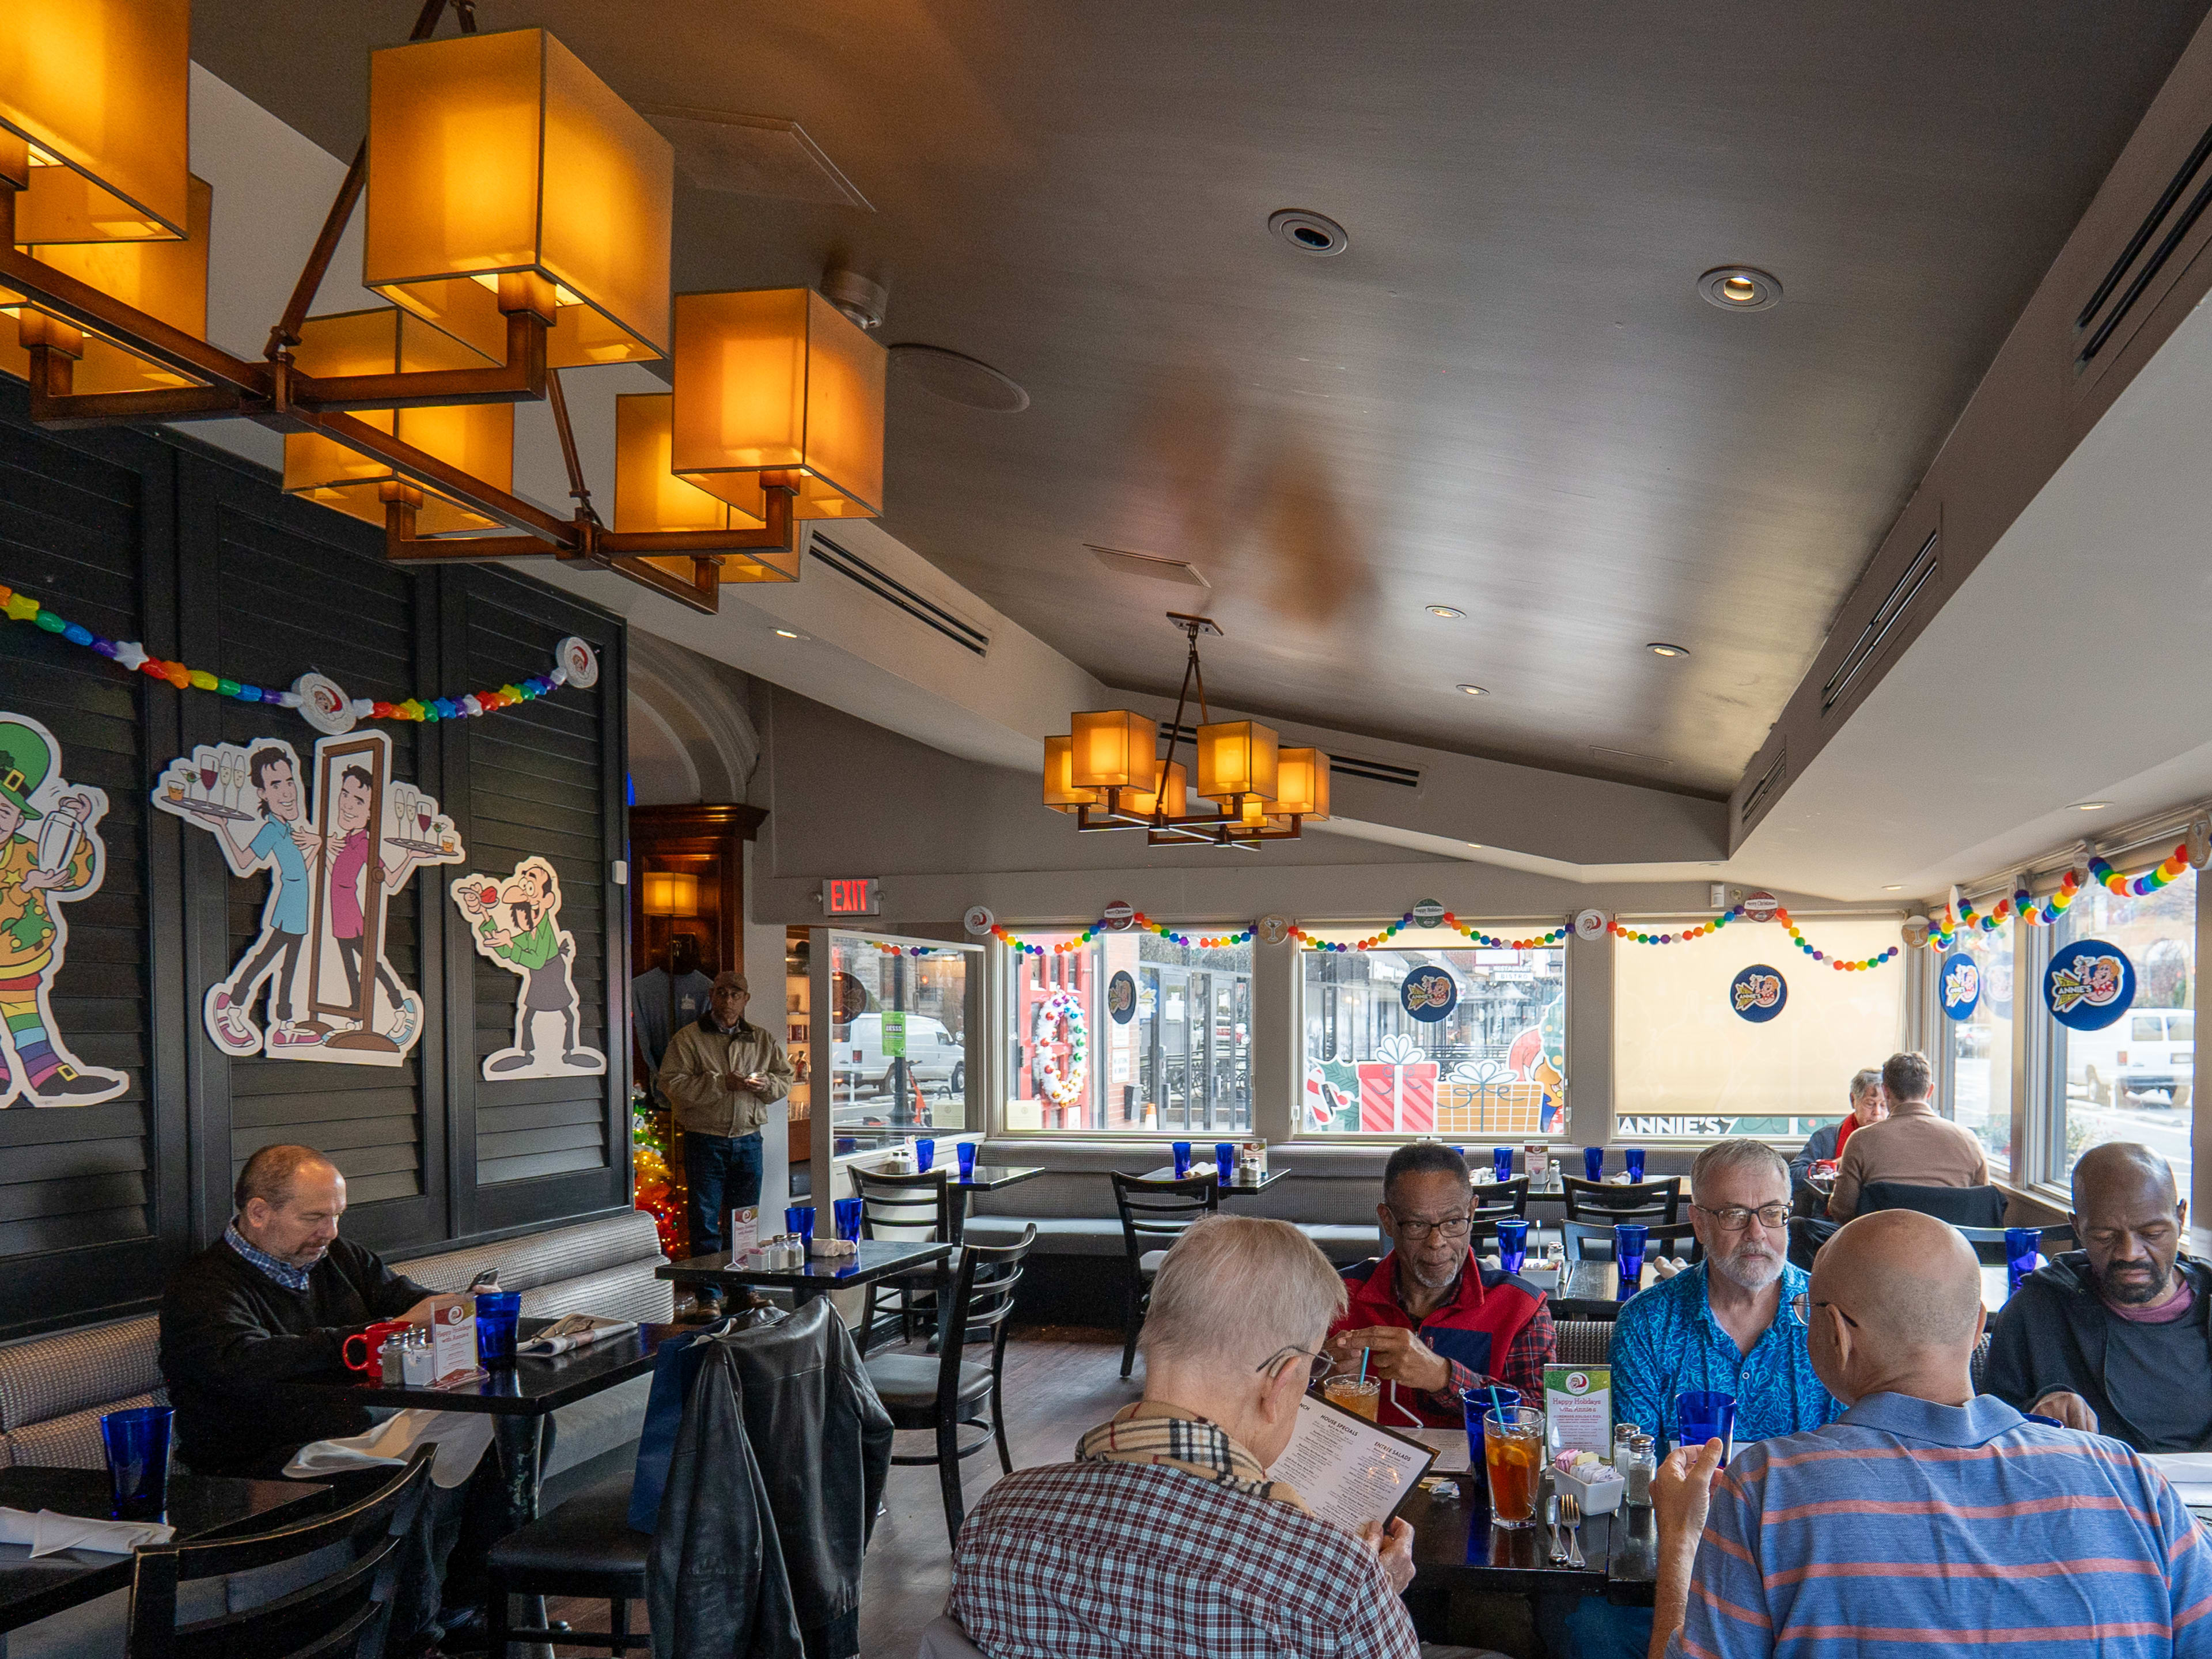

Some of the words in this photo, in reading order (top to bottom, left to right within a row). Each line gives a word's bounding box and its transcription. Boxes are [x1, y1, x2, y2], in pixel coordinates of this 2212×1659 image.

[831, 880, 868, 911] EXIT
[2058, 986, 2092, 994] ANNIE'S
[1619, 1117, 1721, 1134] ANNIE'S
[1320, 1415, 1337, 1425] HOUSE
[1336, 1423, 1358, 1436] SPECIALS
[1392, 1450, 1411, 1461] SALADS
